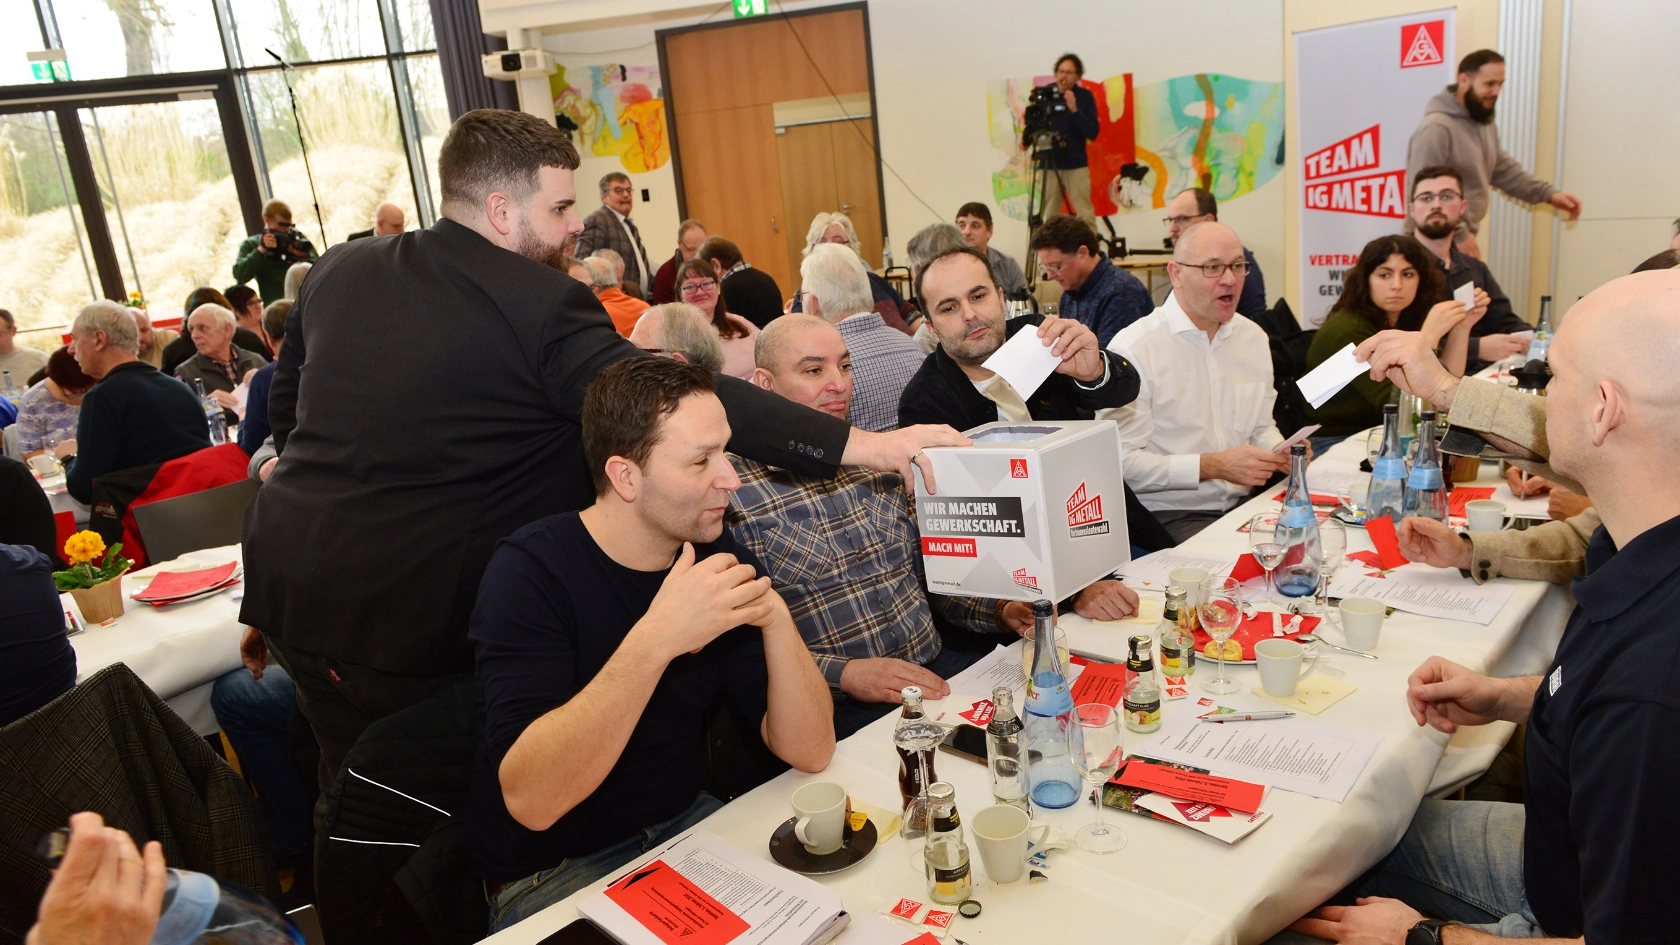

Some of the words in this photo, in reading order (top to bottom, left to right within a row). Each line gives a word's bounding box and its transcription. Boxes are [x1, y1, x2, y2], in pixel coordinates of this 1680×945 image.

[1305, 131, 1376, 178] TEAM
[1307, 184, 1329, 208] IG
[1330, 174, 1406, 215] META
[1309, 254, 1359, 266] VERTRA
[923, 501, 947, 516] WIR
[948, 502, 998, 516] MACHEN
[1066, 486, 1085, 512] TEAM
[1068, 514, 1076, 526] IG
[1075, 498, 1102, 524] METALL
[925, 518, 1021, 534] GEWERKSCHAFT.
[928, 542, 953, 553] MACH
[953, 543, 974, 554] MIT!
